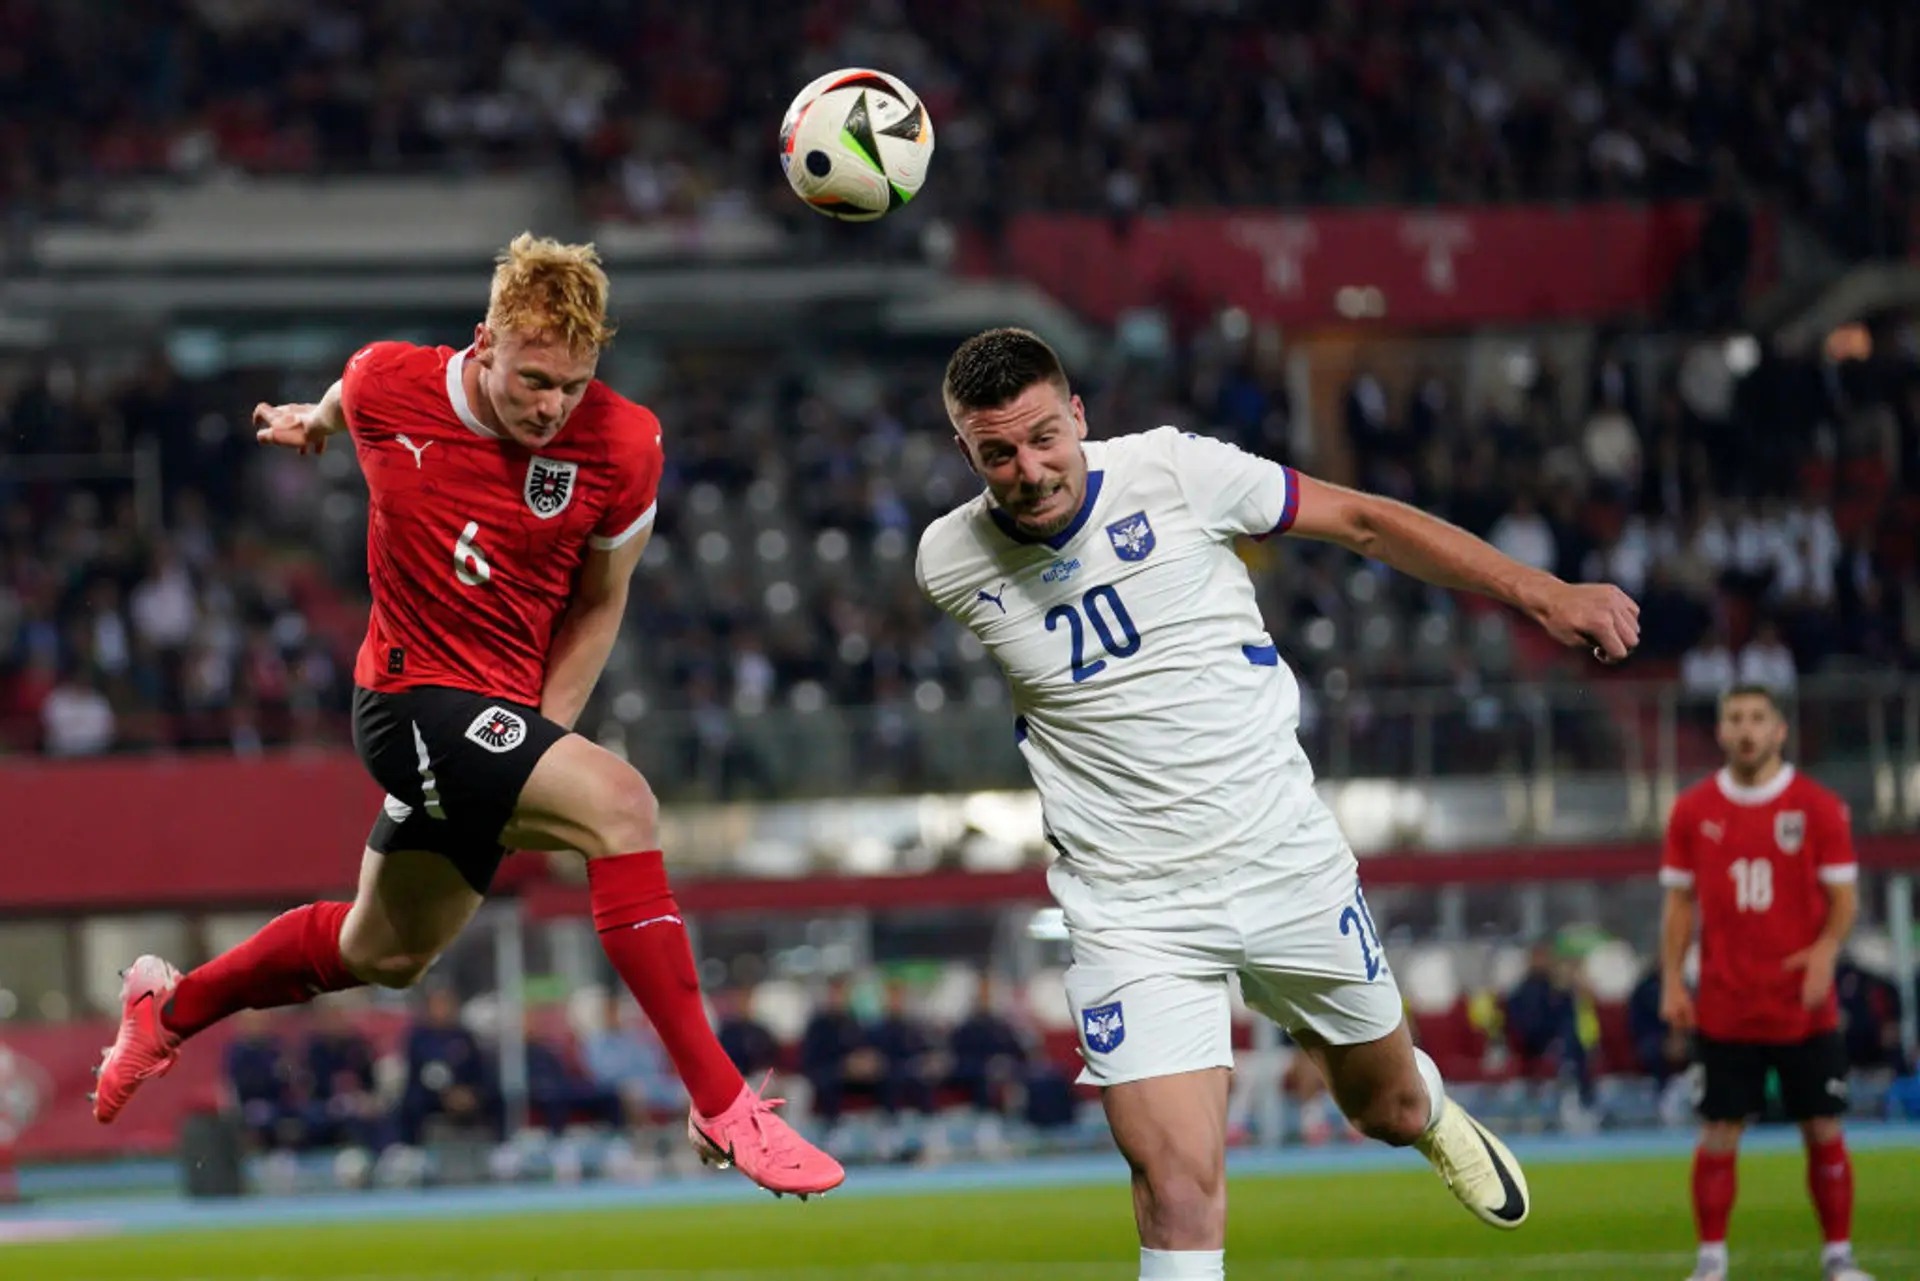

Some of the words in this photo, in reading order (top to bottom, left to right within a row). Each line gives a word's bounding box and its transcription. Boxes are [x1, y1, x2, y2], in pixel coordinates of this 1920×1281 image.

[454, 520, 490, 586] 6
[1044, 584, 1142, 683] 20
[1727, 856, 1774, 914] 18
